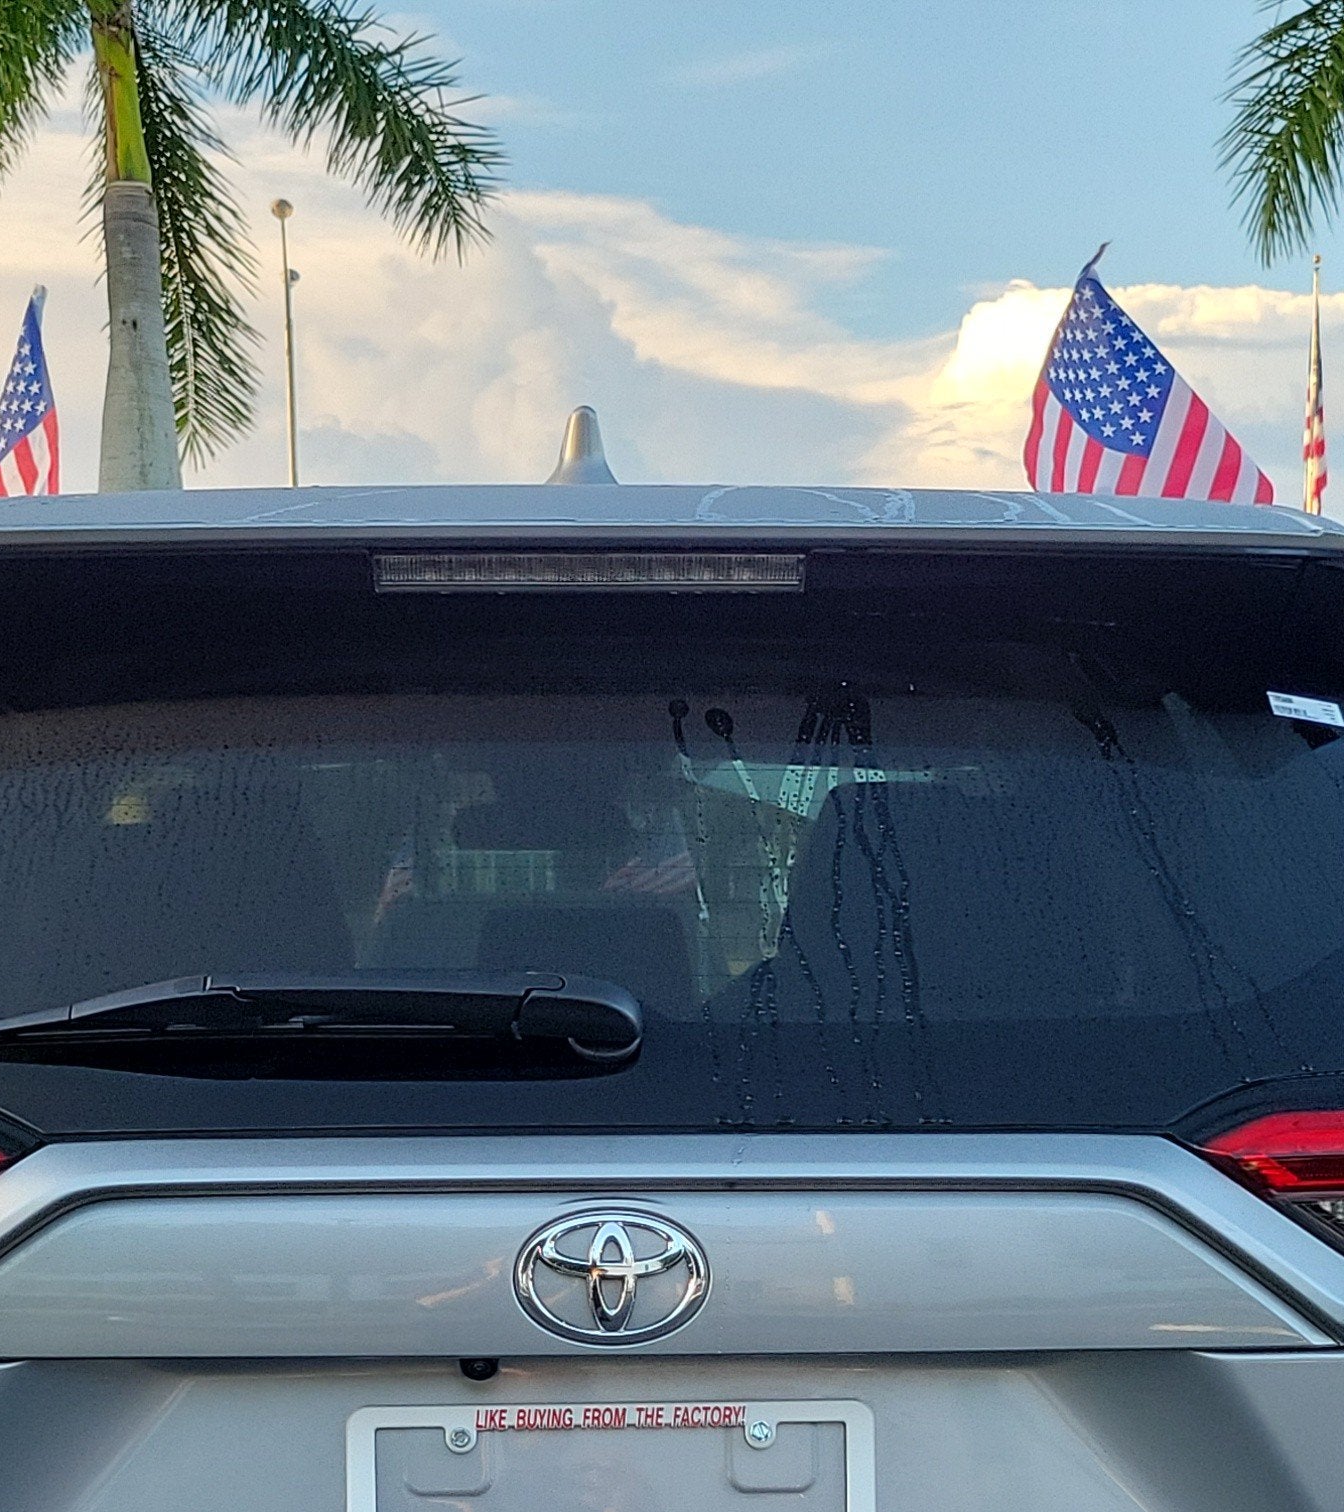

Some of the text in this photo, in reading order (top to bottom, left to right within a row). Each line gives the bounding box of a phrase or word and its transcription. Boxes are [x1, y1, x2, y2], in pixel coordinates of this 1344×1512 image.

[475, 1404, 747, 1431] LIKE BUYING FROM THE FACTORY!
